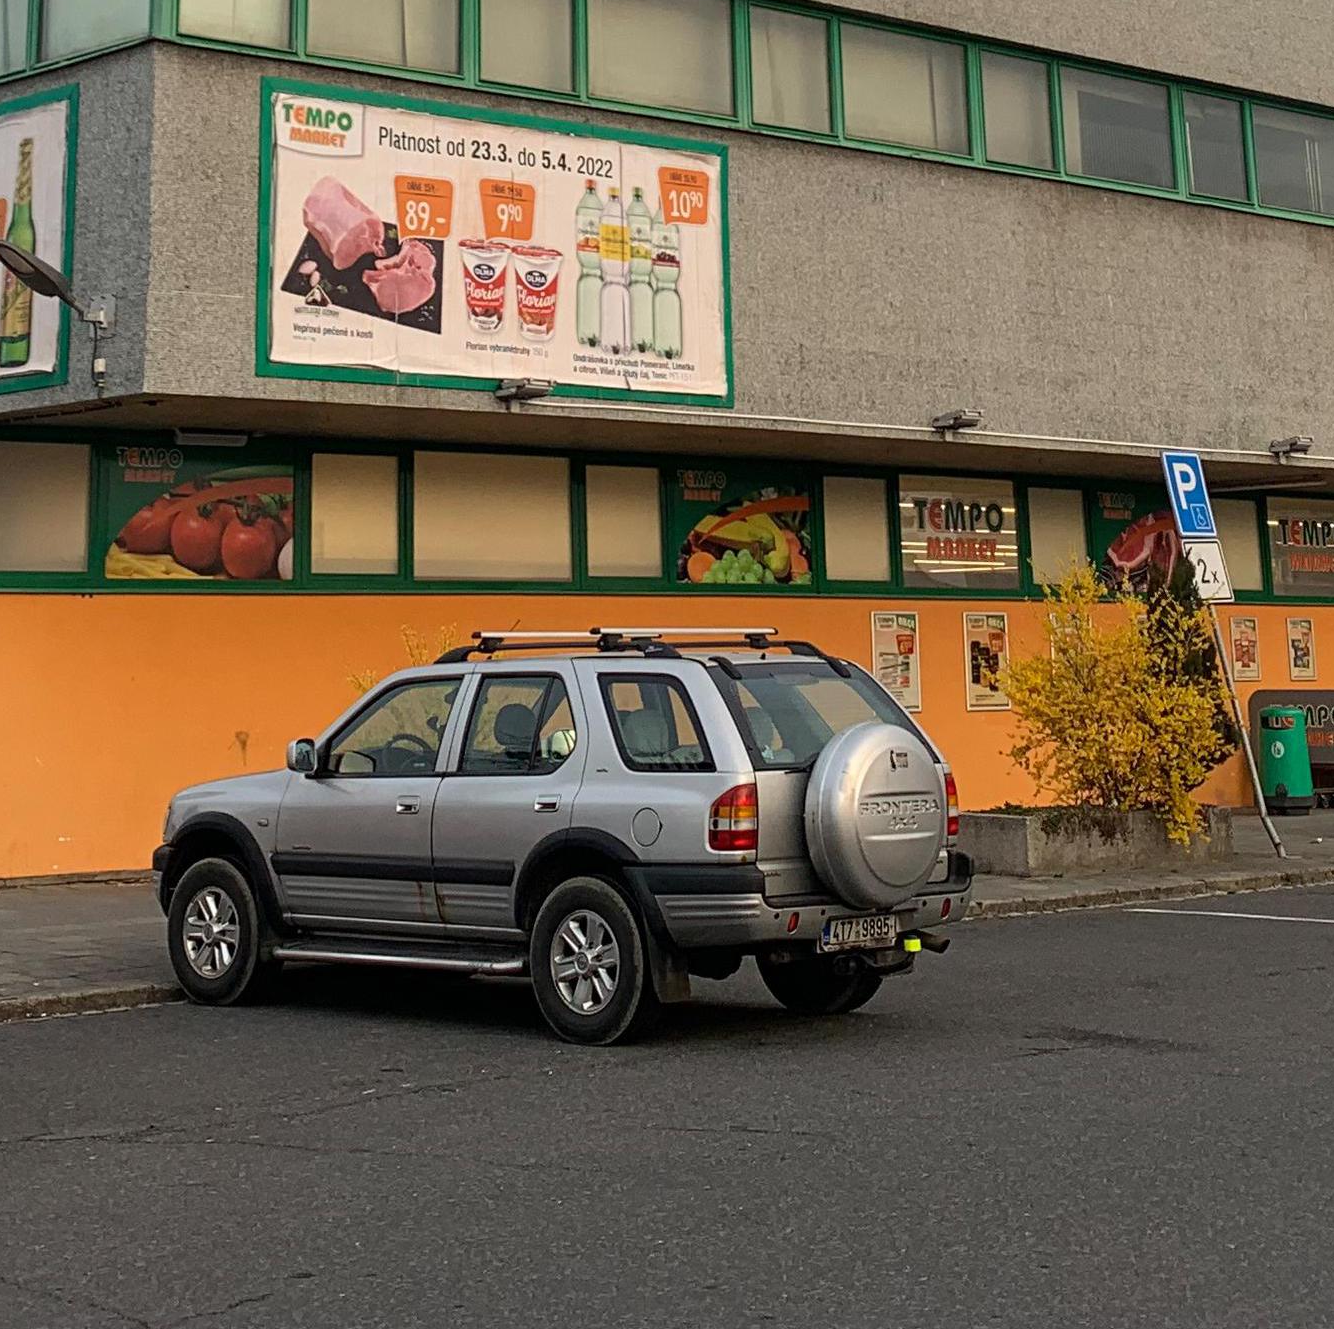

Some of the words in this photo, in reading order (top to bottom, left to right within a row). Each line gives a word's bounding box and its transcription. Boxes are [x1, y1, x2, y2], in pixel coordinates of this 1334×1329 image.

[282, 104, 352, 131] TEMPO
[379, 126, 441, 154] Platnost
[446, 138, 465, 157] od
[471, 140, 512, 163] 23.3.
[518, 148, 536, 167] do
[542, 150, 571, 172] 5.4.
[577, 156, 613, 179] 2022
[405, 200, 446, 236] 89,-
[526, 275, 546, 283] OLMA
[116, 446, 184, 469] TEMPO
[1172, 462, 1197, 509] P
[912, 497, 1003, 532] TEMPO
[860, 799, 941, 815] FRONTERA
[833, 920, 854, 942] 4T7
[862, 917, 890, 938] 9895
